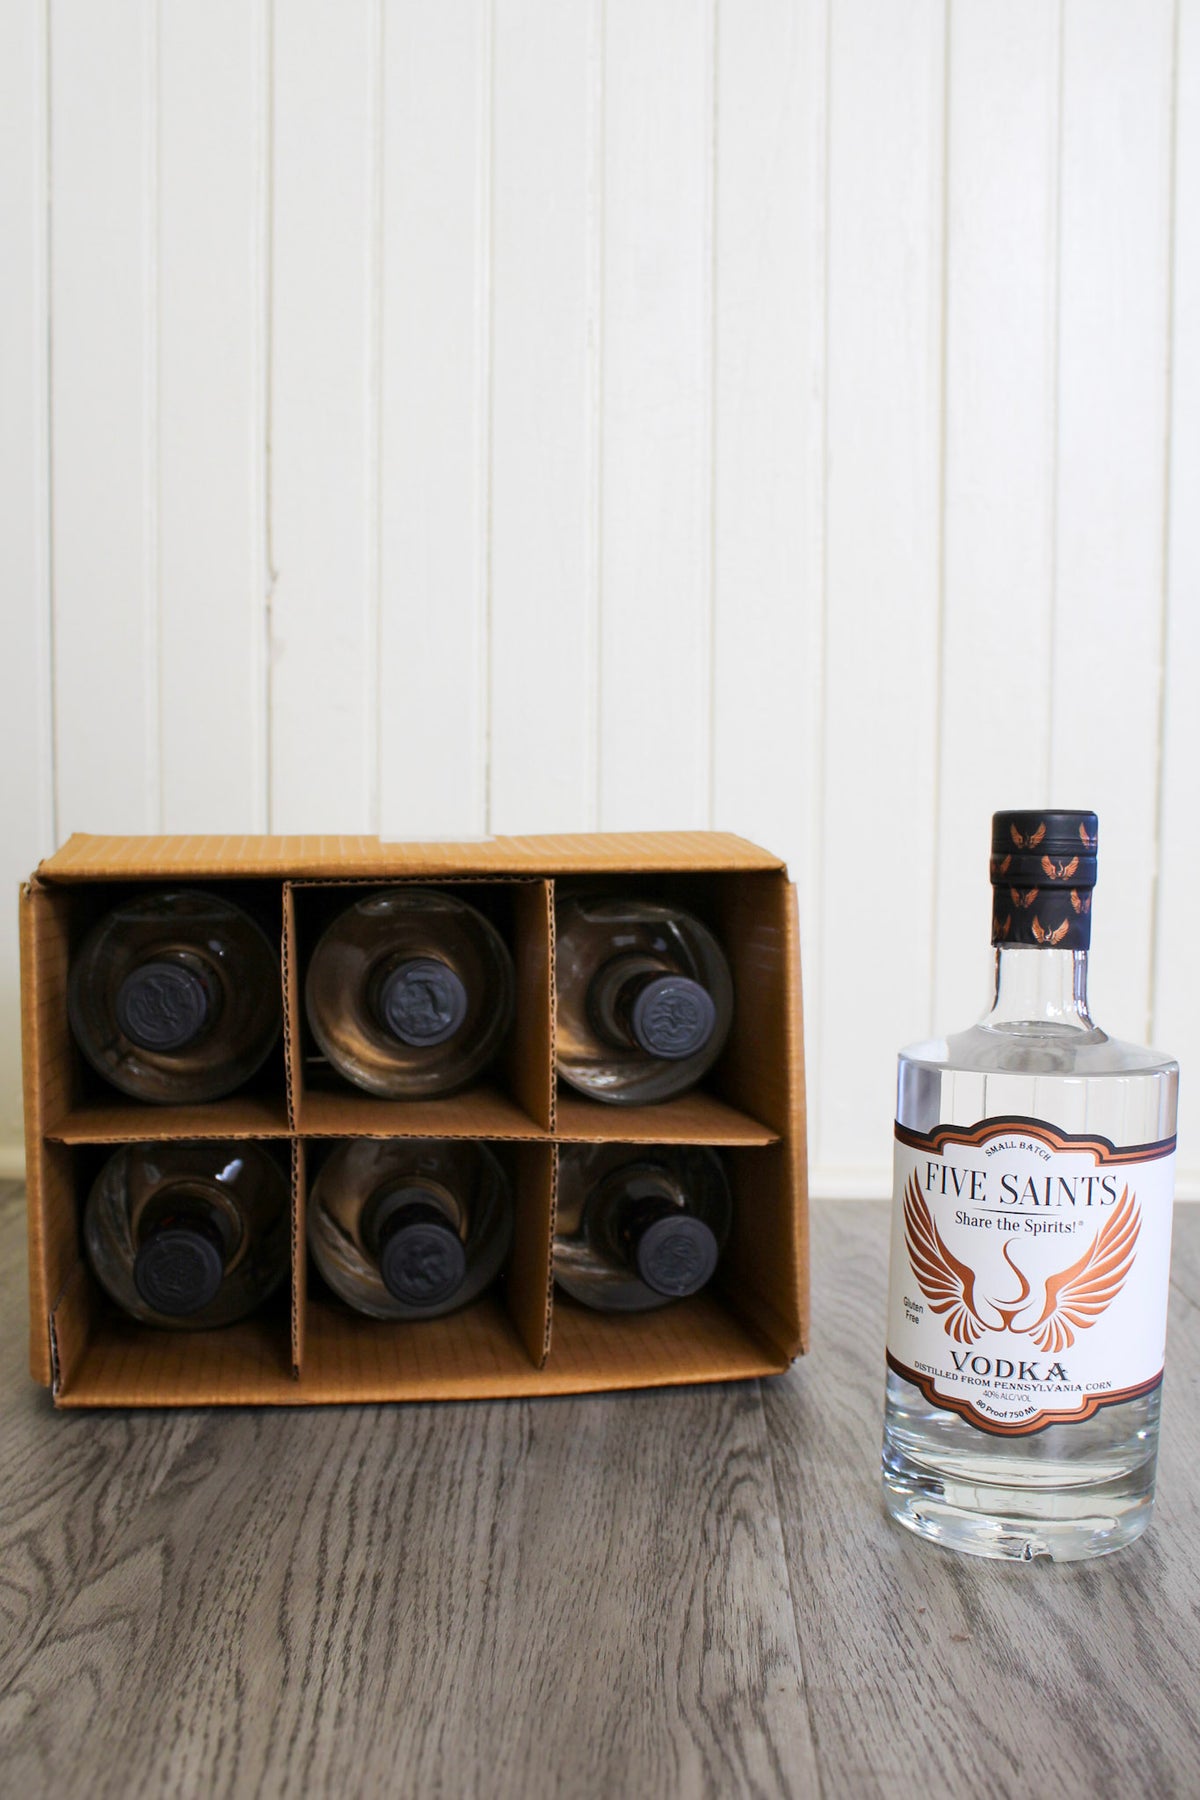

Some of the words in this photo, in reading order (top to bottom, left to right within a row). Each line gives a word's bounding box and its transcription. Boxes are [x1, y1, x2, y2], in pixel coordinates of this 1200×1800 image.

[985, 1141, 1016, 1157] SMALL
[1019, 1142, 1052, 1161] BATCH
[925, 1161, 986, 1201] FIVE
[1000, 1174, 1117, 1207] SAINTS
[955, 1210, 992, 1229] Share
[997, 1217, 1020, 1231] the
[903, 1297, 924, 1314] Gluten
[905, 1310, 920, 1324] Free
[950, 1350, 1070, 1381] VODKA
[914, 1361, 958, 1381] DISTILLED
[961, 1375, 990, 1388] FROM
[994, 1382, 1082, 1392] PENNSYLVANIA
[1085, 1381, 1112, 1391] CORN
[982, 1389, 999, 1400] 40%
[1000, 1391, 1032, 1402] ALC/VOL
[976, 1399, 986, 1409] 80
[986, 1405, 1008, 1418] Proof
